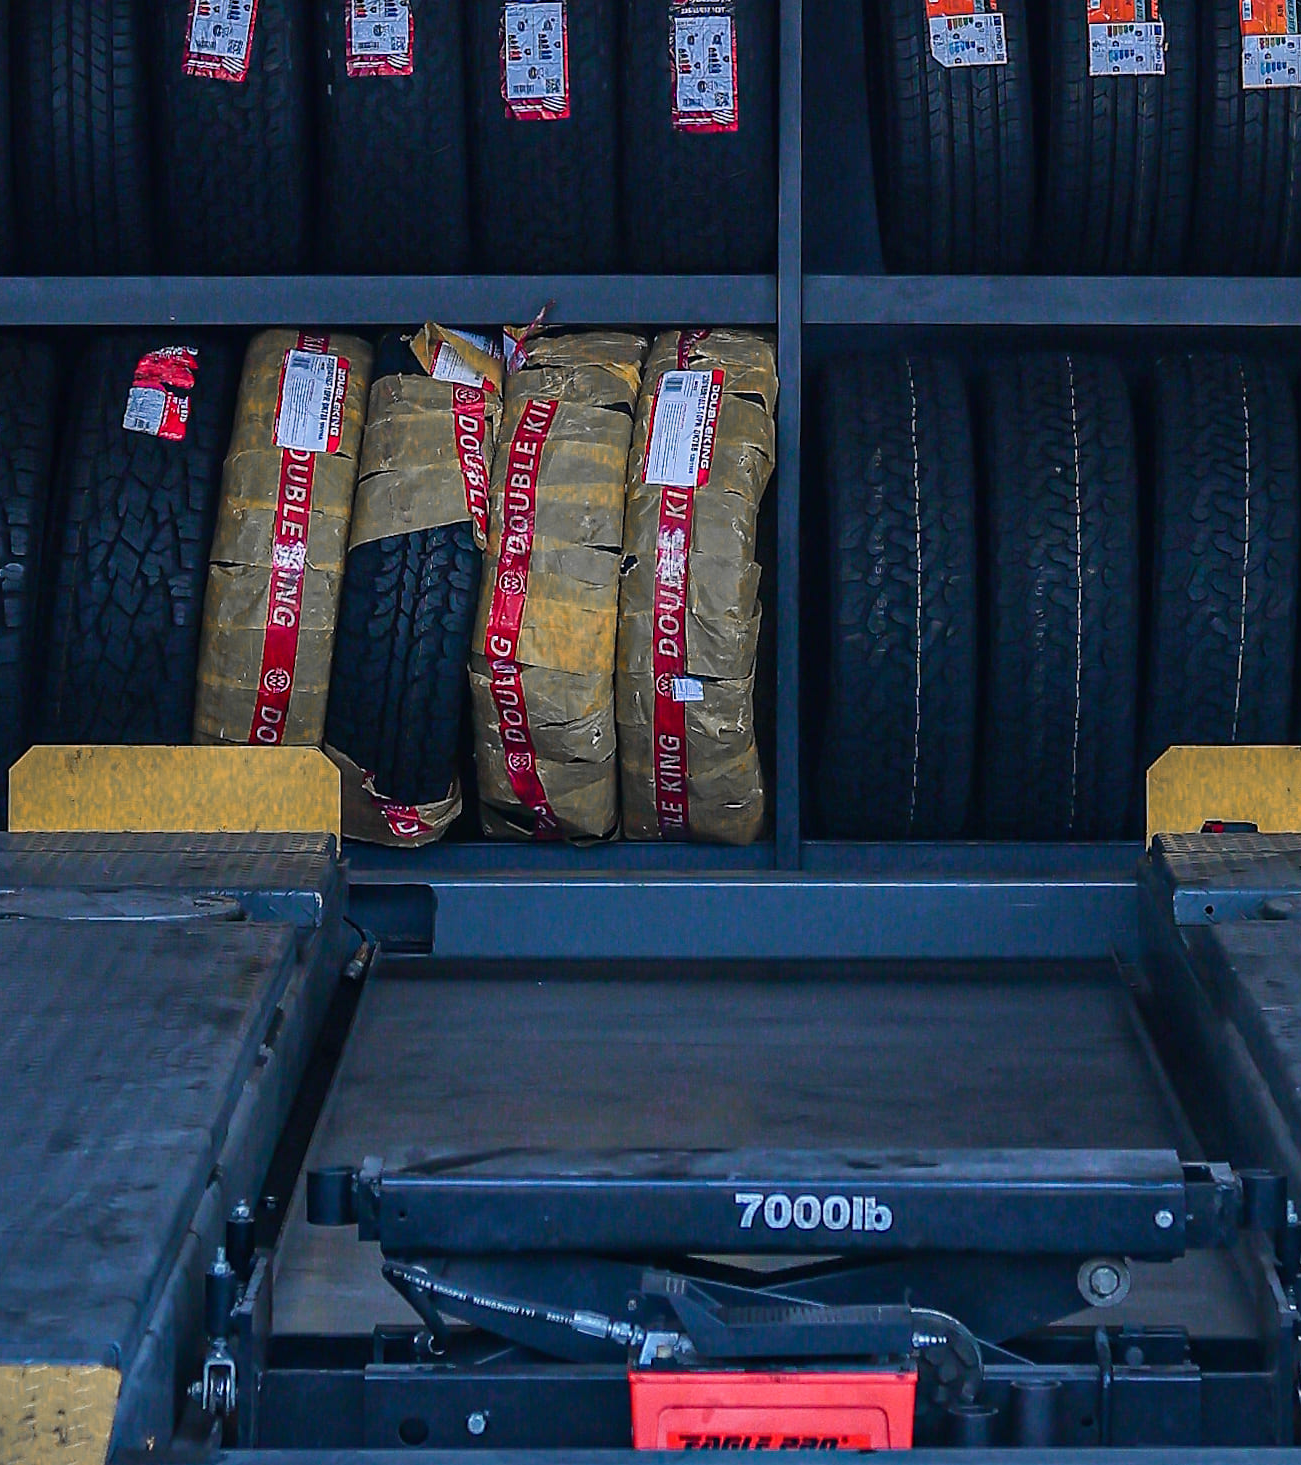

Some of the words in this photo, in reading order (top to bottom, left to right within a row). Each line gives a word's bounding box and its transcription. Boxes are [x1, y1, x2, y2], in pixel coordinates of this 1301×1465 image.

[329, 368, 347, 437] DOUBLEKING
[699, 384, 721, 470] DOUBLEKING
[504, 440, 538, 556] DOUBLE
[660, 733, 682, 790] KING
[734, 1192, 894, 1232] 7000lb
